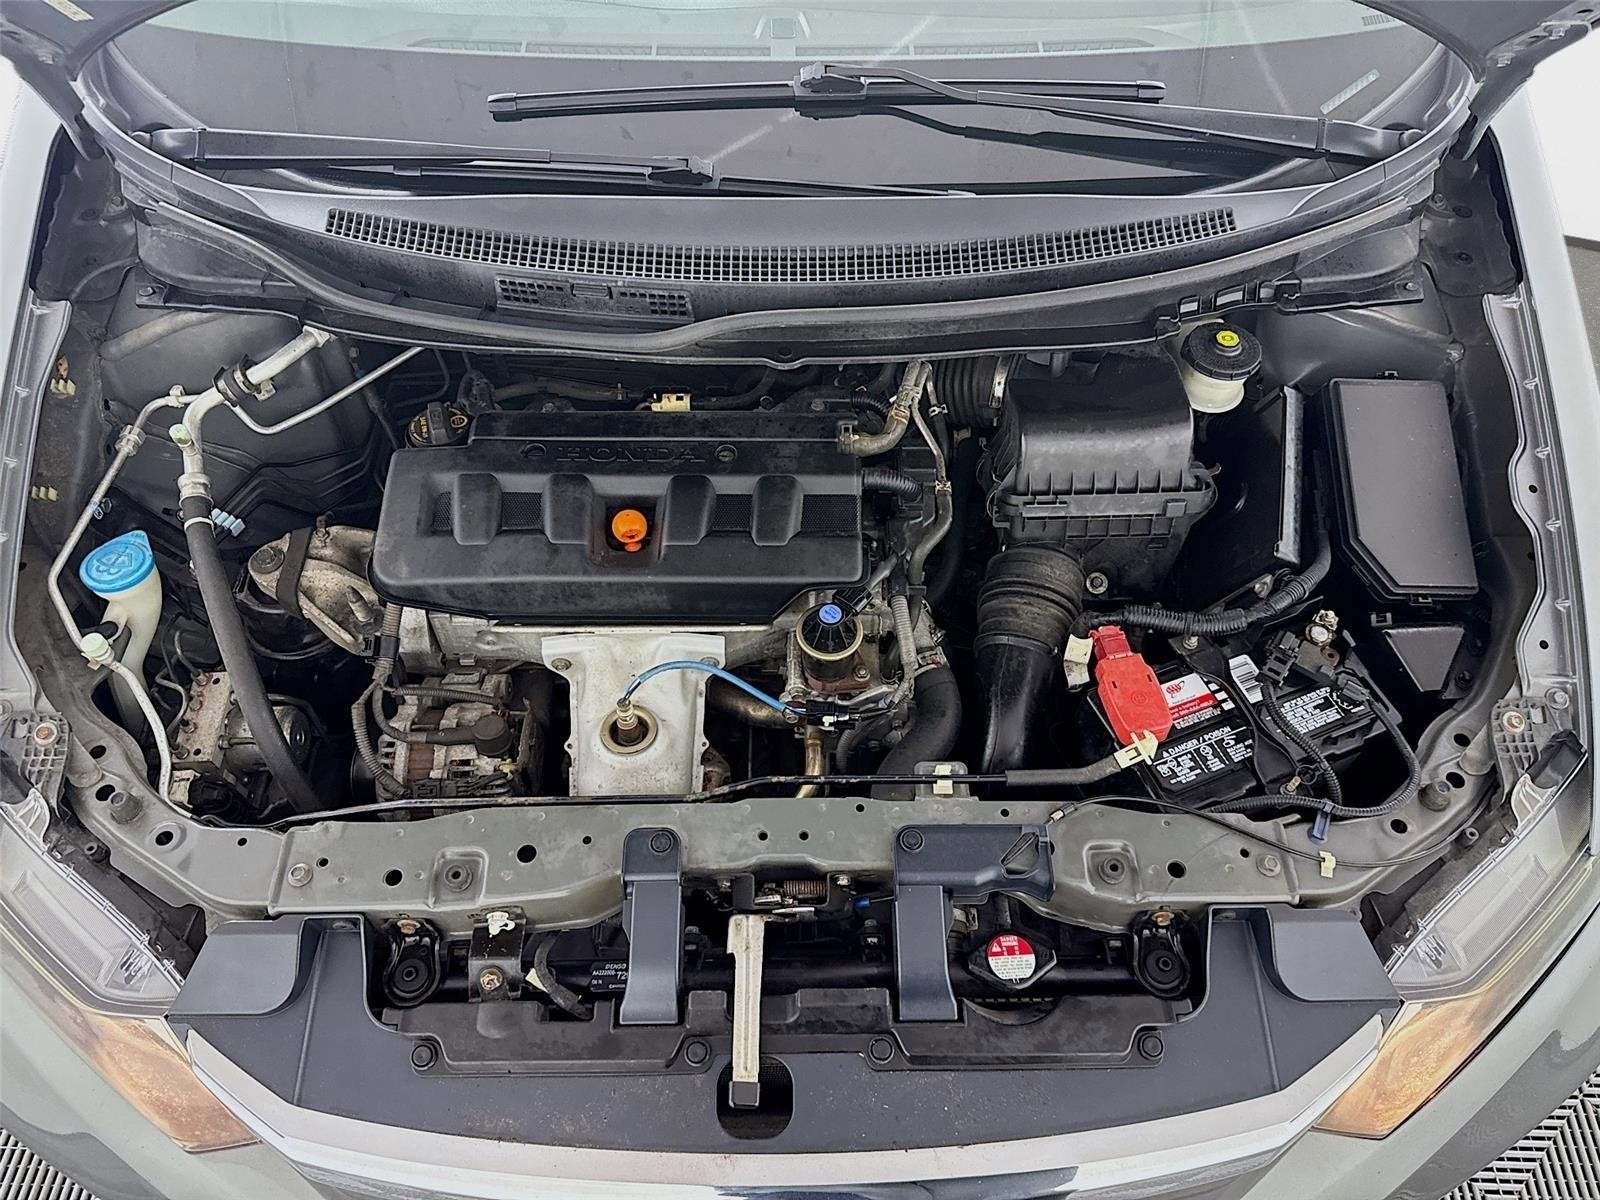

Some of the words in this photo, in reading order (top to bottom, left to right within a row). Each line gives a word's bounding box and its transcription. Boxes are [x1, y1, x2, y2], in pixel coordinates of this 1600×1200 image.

[556, 447, 705, 462] HONDA
[1168, 739, 1199, 754] DANGER
[1203, 726, 1232, 741] POISON
